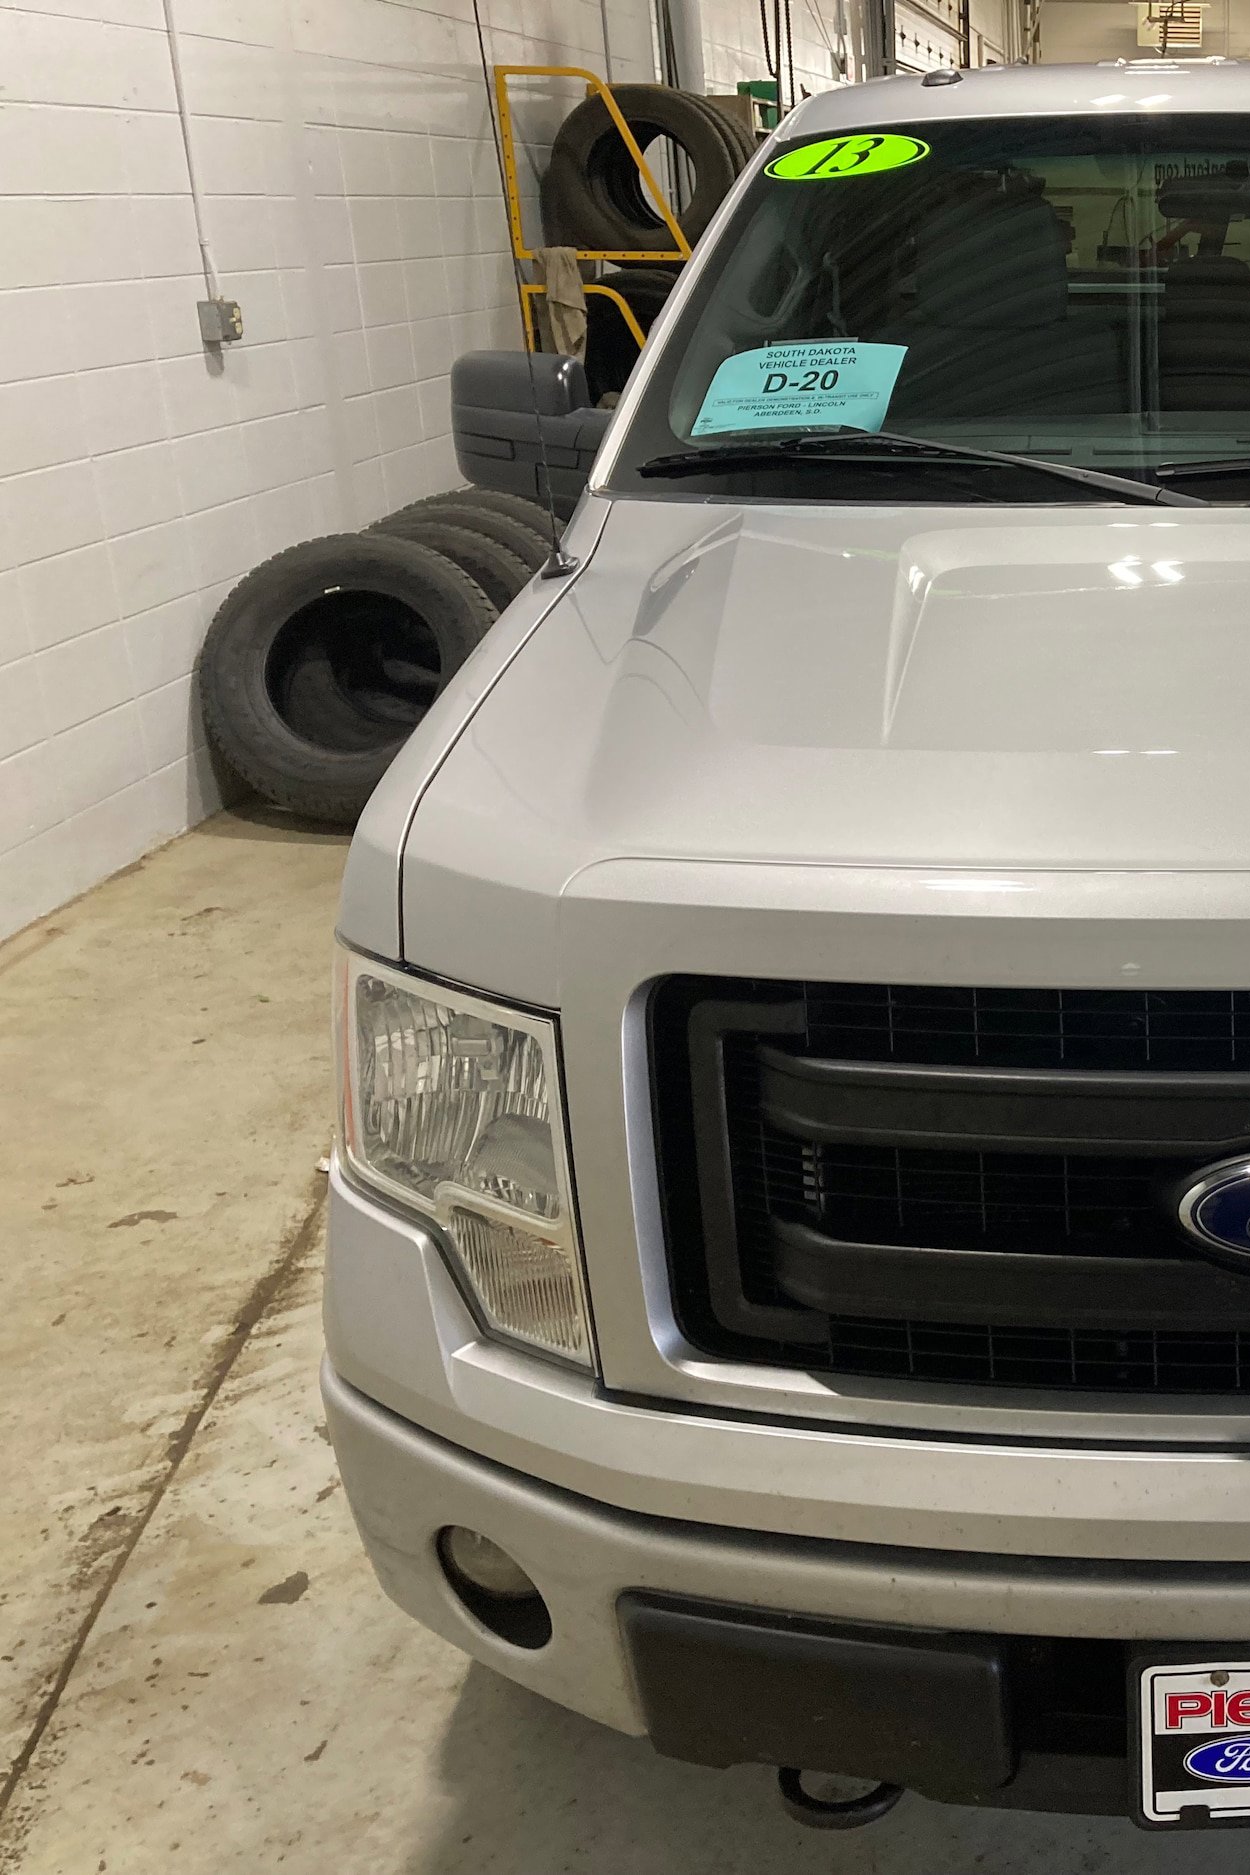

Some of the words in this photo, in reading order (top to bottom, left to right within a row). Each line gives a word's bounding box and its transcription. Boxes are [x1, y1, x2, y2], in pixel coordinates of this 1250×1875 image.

[796, 137, 885, 177] 13
[766, 349, 805, 359] SOUTH
[808, 347, 856, 356] DAKOTA
[759, 359, 807, 369] VEHICLE
[810, 357, 857, 366] DEALER
[762, 369, 839, 394] D-20
[737, 403, 775, 411] PIERSON
[776, 402, 801, 410] FORD
[754, 409, 802, 417] ABERDEEN,
